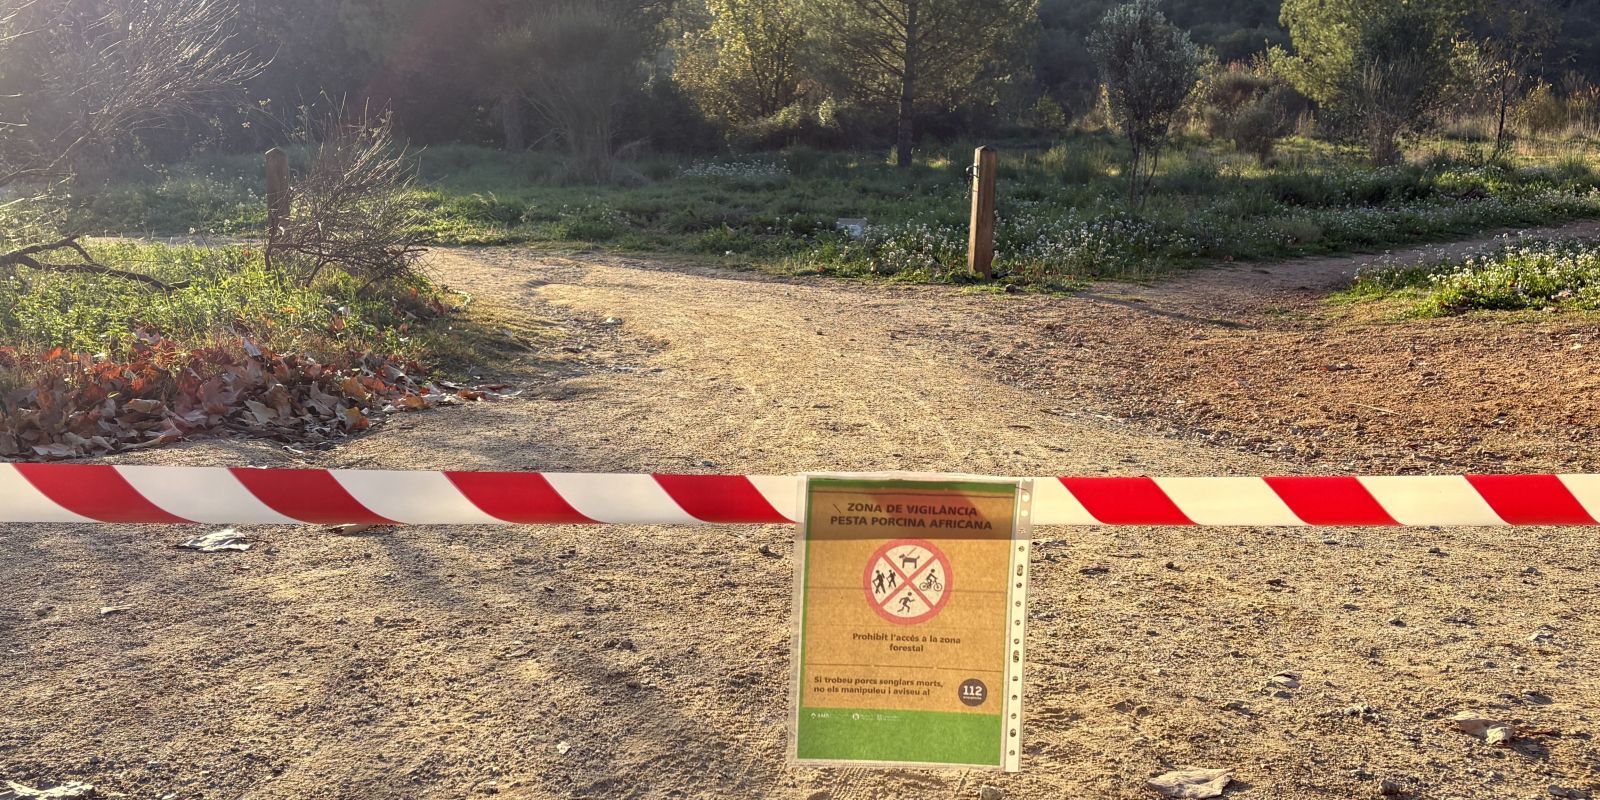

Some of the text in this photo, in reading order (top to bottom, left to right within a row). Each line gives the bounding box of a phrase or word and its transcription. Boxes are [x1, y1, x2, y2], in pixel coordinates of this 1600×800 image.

[847, 502, 882, 513] ZONA
[886, 504, 903, 513] DE
[830, 515, 993, 530] PESTA PORCINA AFRICANA
[852, 632, 889, 641] Prohibit
[929, 635, 938, 643] la
[939, 637, 961, 645] zona
[889, 643, 924, 652] forestal
[824, 676, 853, 684] trobeu
[879, 678, 915, 687] senglars
[916, 680, 944, 688] morts,
[841, 687, 886, 695] manipuleu
[893, 688, 920, 696] aviseu
[963, 685, 982, 696] 112
